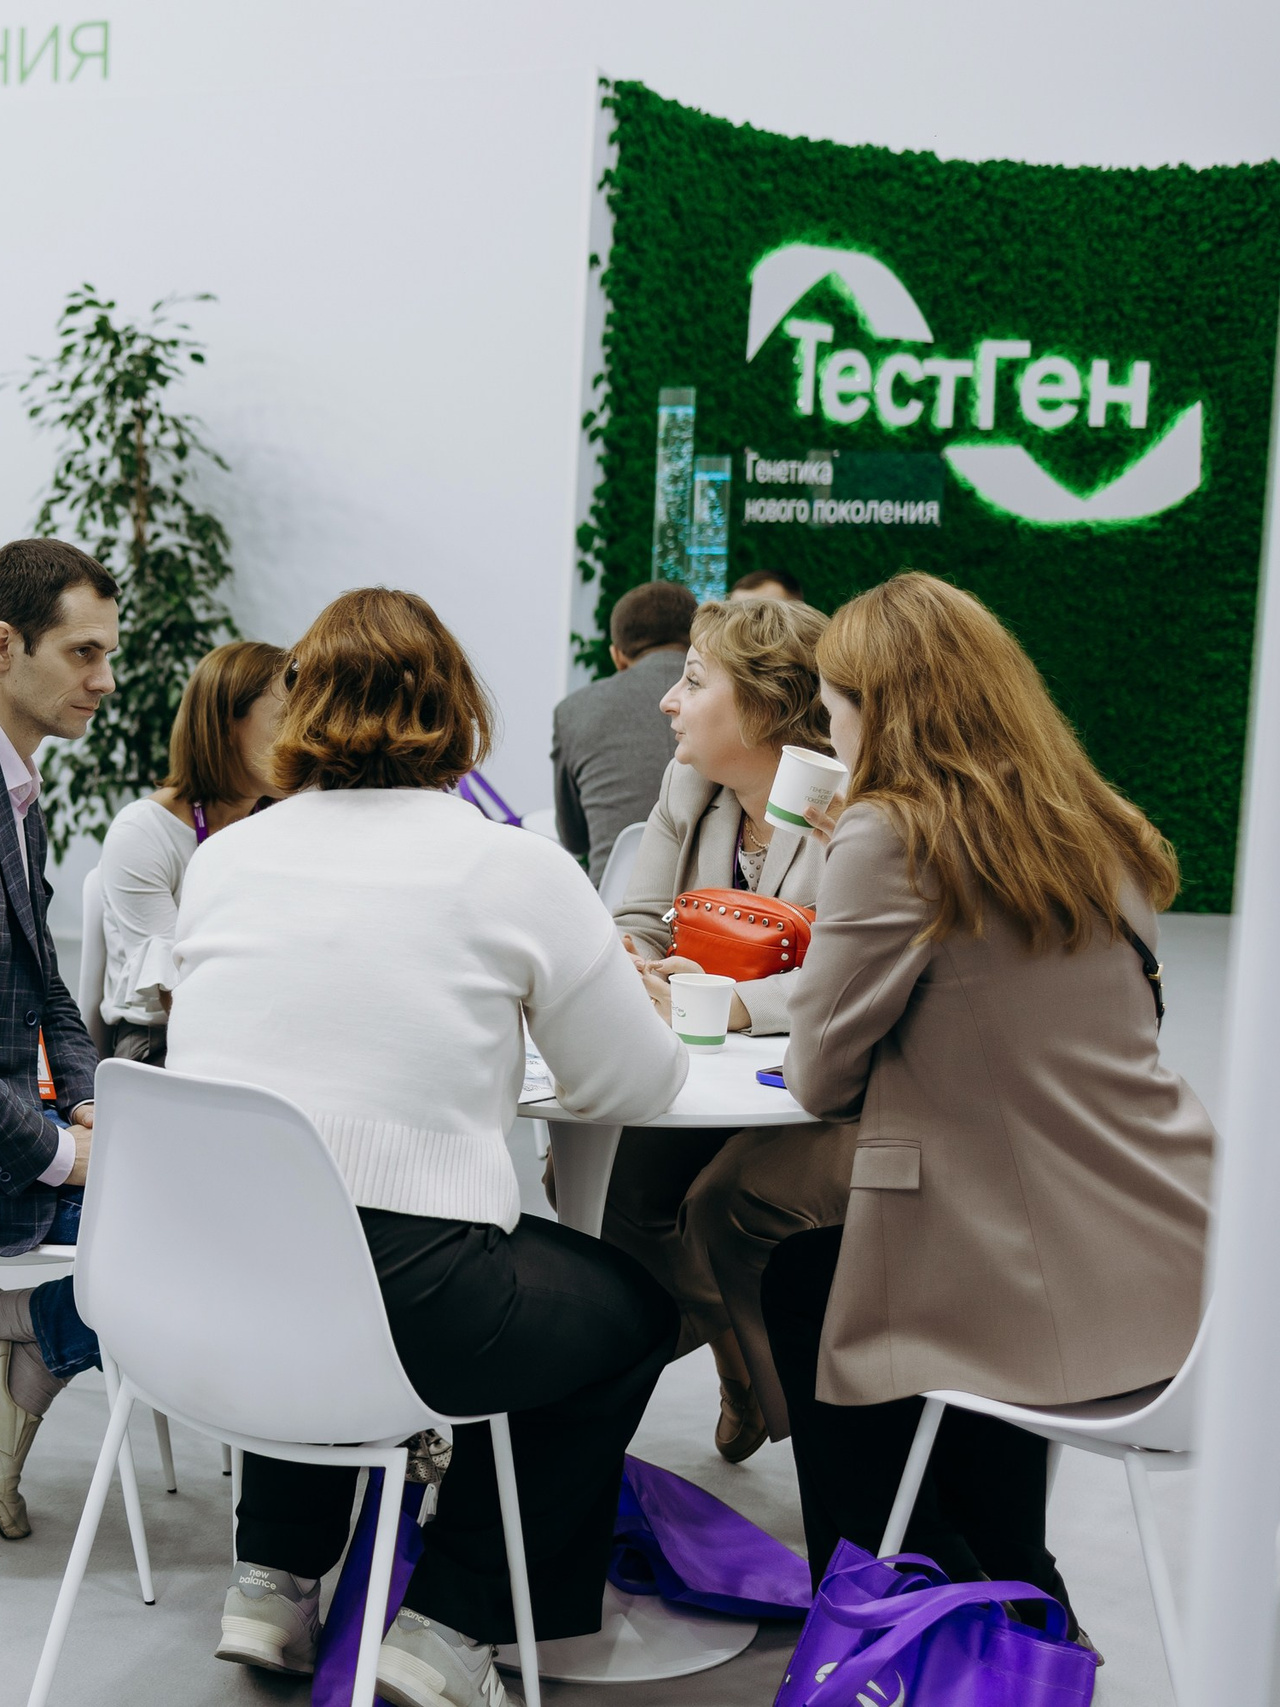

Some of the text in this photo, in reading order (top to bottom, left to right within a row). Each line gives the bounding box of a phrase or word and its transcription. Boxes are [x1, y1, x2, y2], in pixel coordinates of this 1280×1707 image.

[786, 318, 1151, 430] ТестГен
[745, 451, 834, 485] Генетика
[744, 498, 940, 525] нового поколения
[238, 1575, 277, 1590] balance
[249, 1569, 270, 1579] new
[398, 1608, 430, 1627] alance
